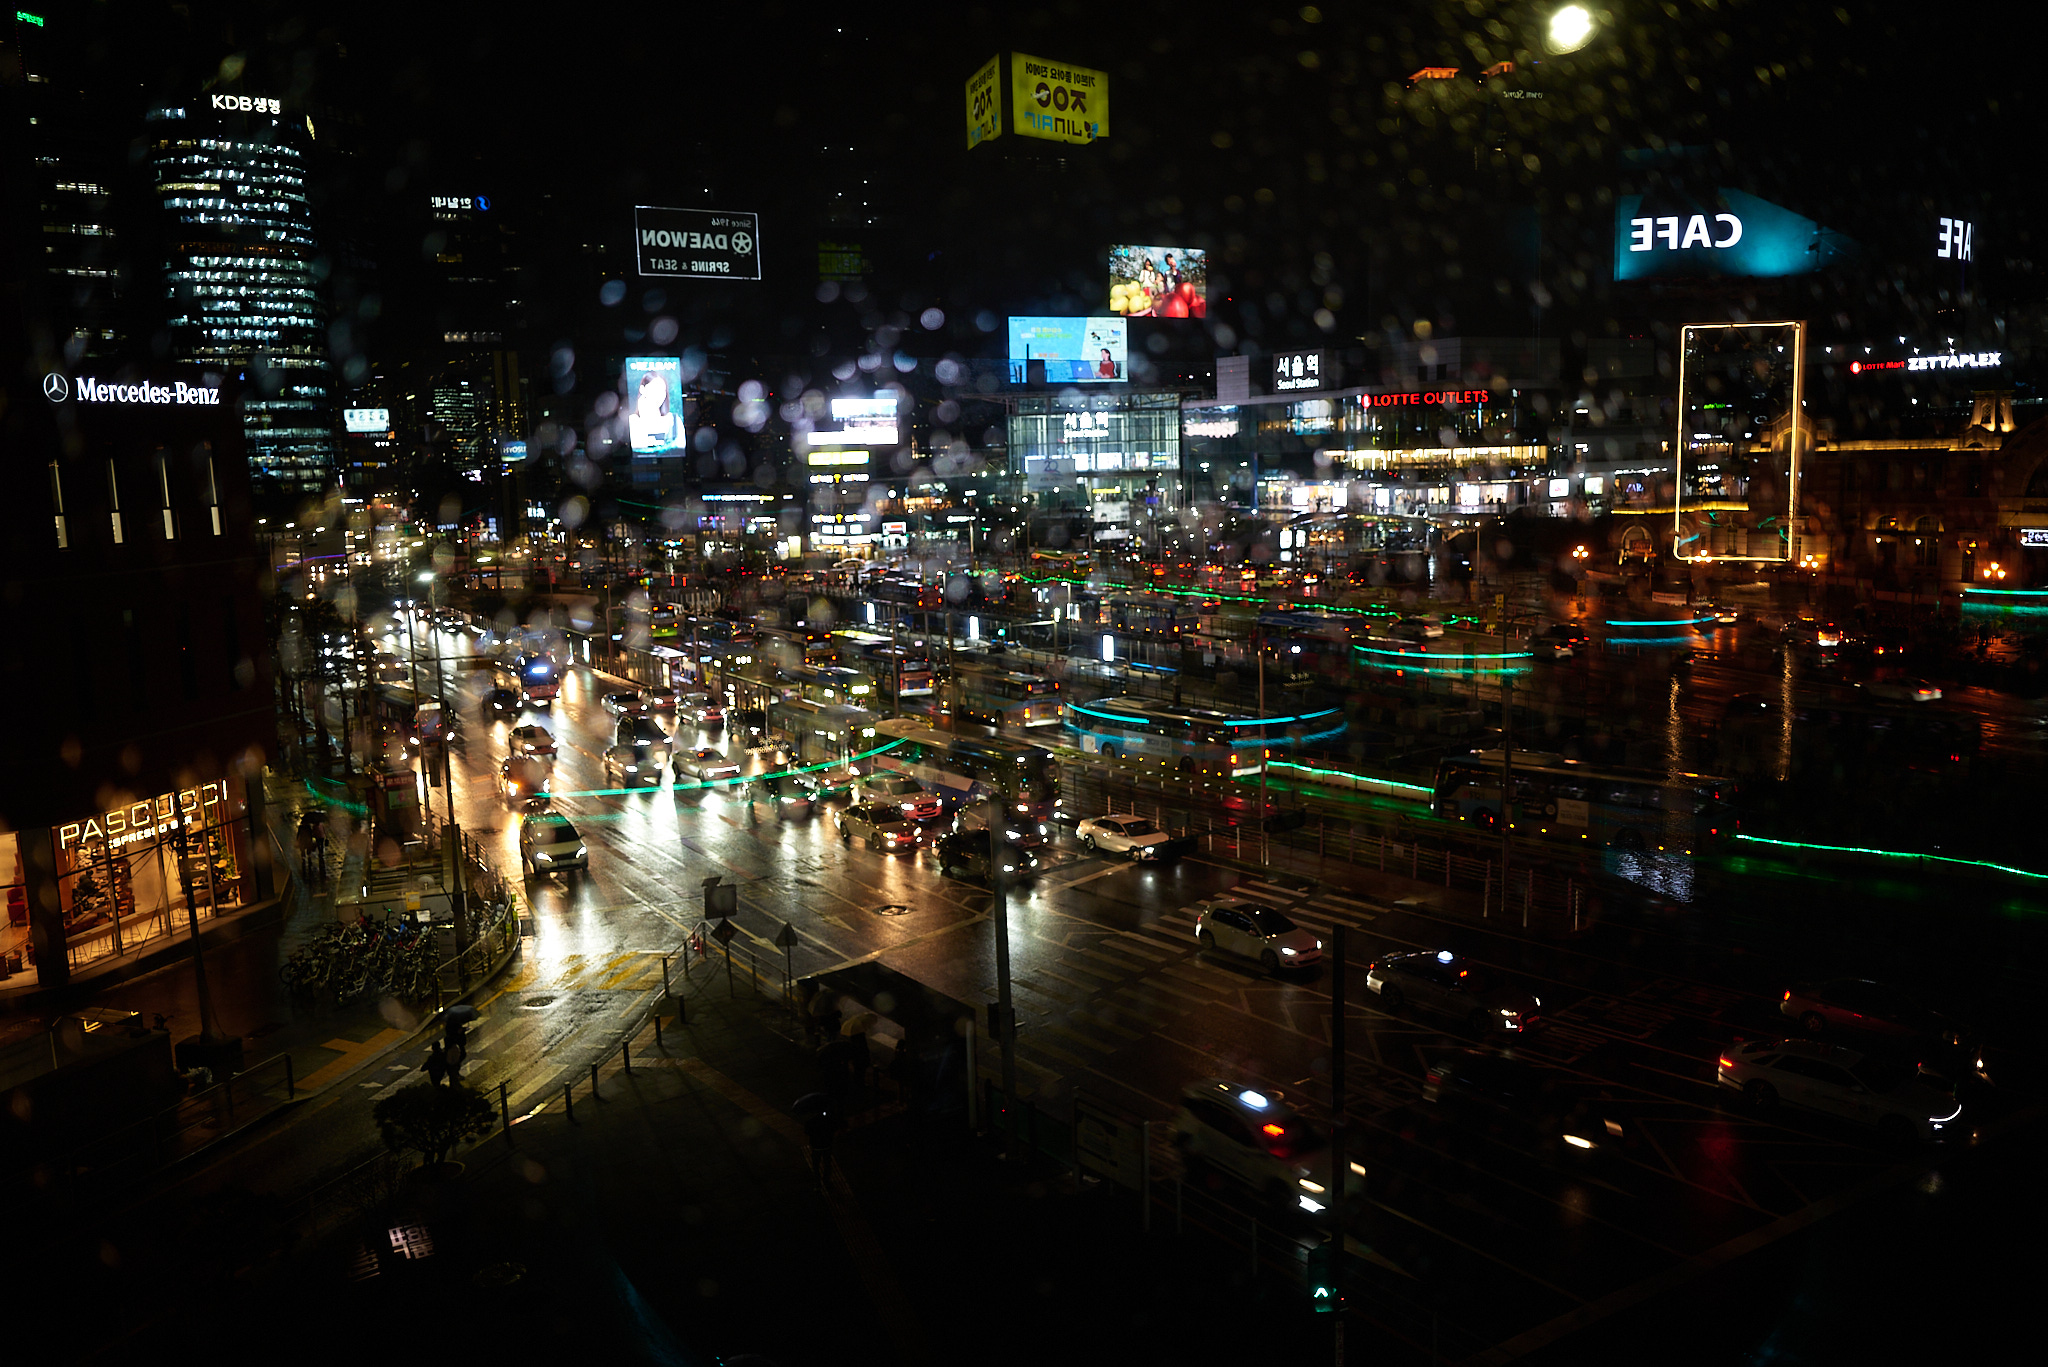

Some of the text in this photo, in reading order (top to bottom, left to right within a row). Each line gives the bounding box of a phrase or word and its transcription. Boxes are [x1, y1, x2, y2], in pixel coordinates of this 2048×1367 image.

[211, 94, 281, 115] KDB생명
[1276, 354, 1319, 378] 서울역
[1862, 352, 2002, 371] LOTTE Mart ZETTAPLEX
[75, 377, 220, 405] Mercedes-Benz
[1277, 377, 1319, 390] Seoul Station
[1373, 389, 1489, 407] LOTTE OUTLETS
[1063, 411, 1109, 430] 서울역
[59, 779, 228, 850] PASCUCCI
[170, 814, 193, 830] BR
